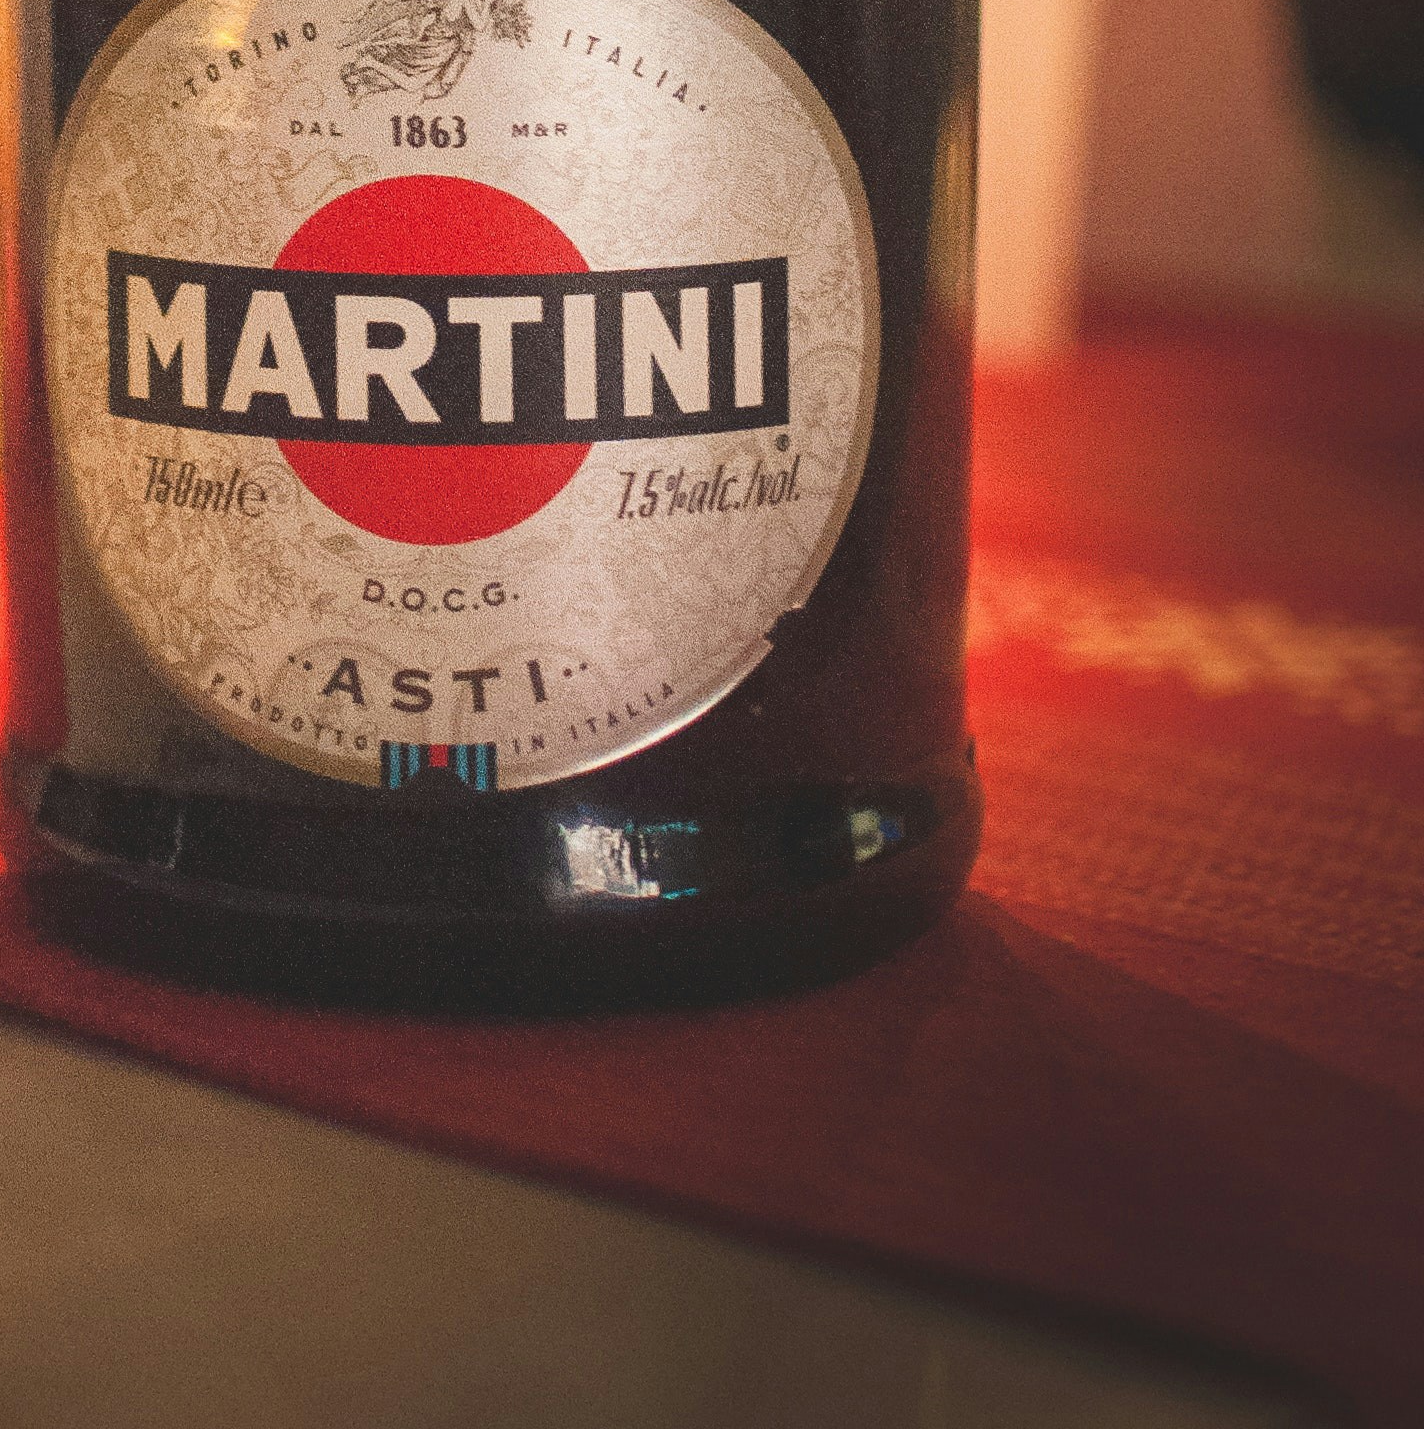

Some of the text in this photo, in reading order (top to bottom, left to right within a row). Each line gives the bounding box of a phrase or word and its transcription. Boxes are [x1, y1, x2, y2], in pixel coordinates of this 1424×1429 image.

[183, 21, 688, 103] TORINO ITALIA
[289, 114, 568, 149] DAL 1863 M&R
[125, 273, 765, 424] MARTINI
[362, 577, 521, 613] D.O.C.G.
[210, 671, 674, 756] PRODOTTO IN ITALIA
[321, 656, 549, 714] ASTI
